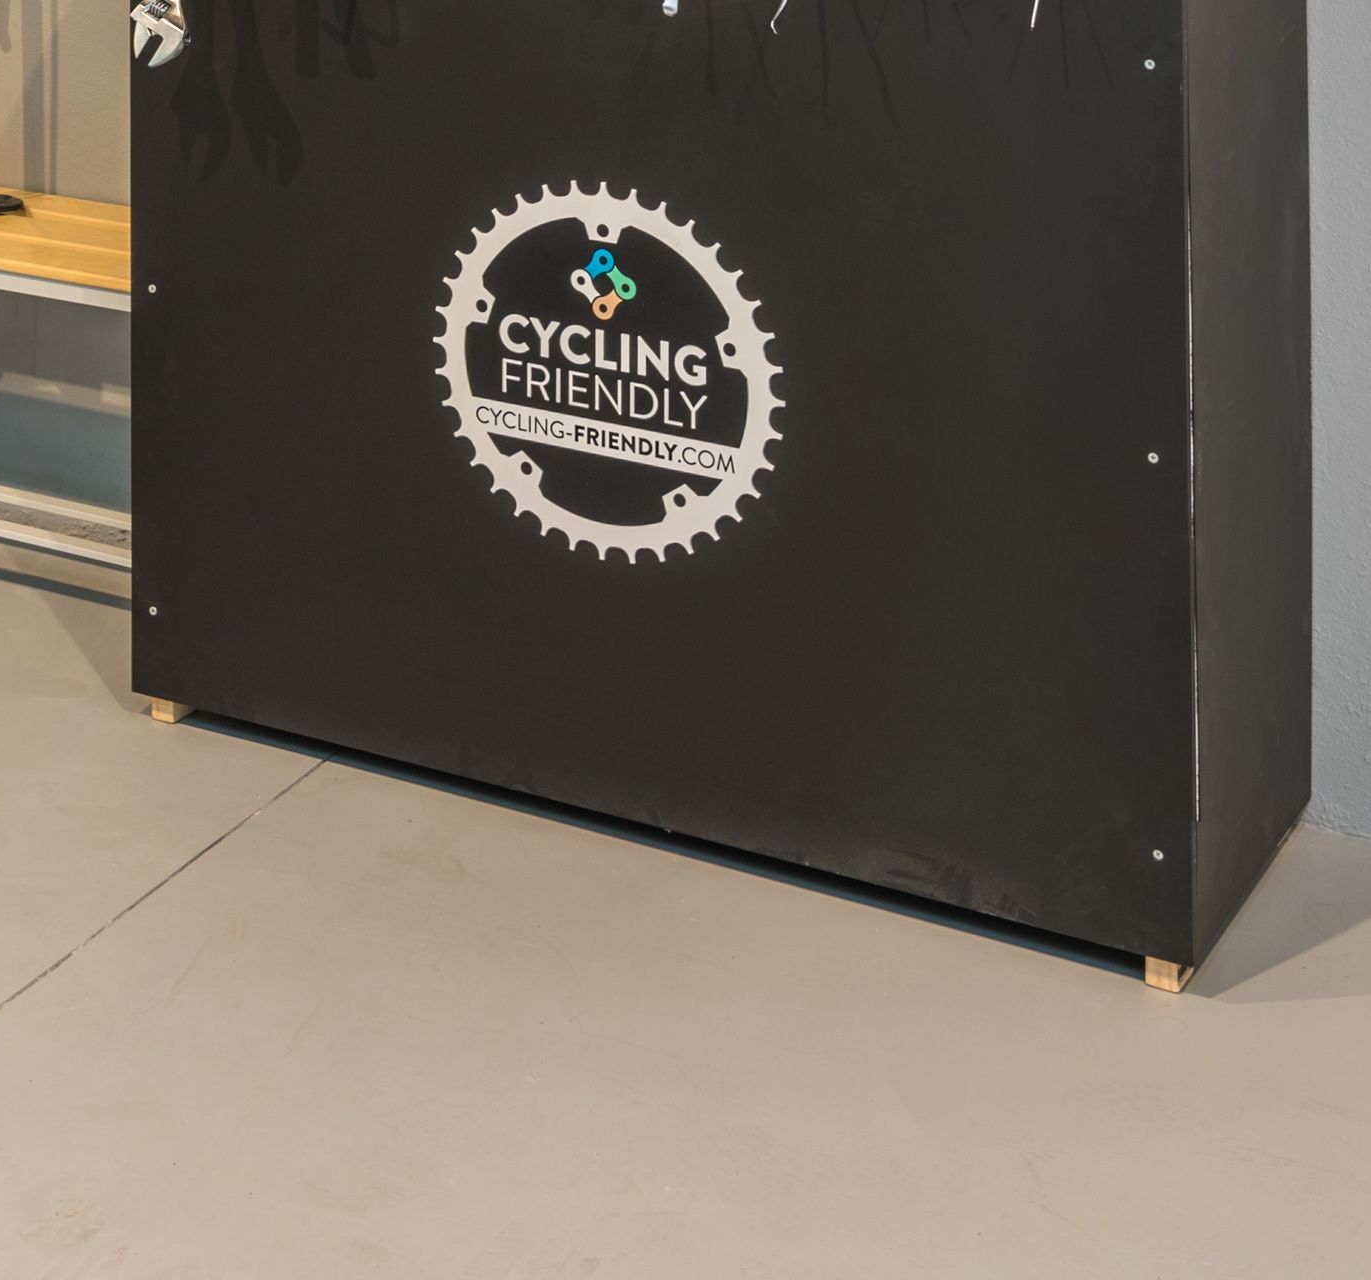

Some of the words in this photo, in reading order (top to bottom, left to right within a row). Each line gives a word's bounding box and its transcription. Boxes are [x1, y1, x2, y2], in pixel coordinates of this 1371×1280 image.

[498, 312, 707, 386] CYCLING
[501, 357, 708, 430] FRIENDLY
[475, 405, 735, 474] CYCLING-FRIENDLY.COM
